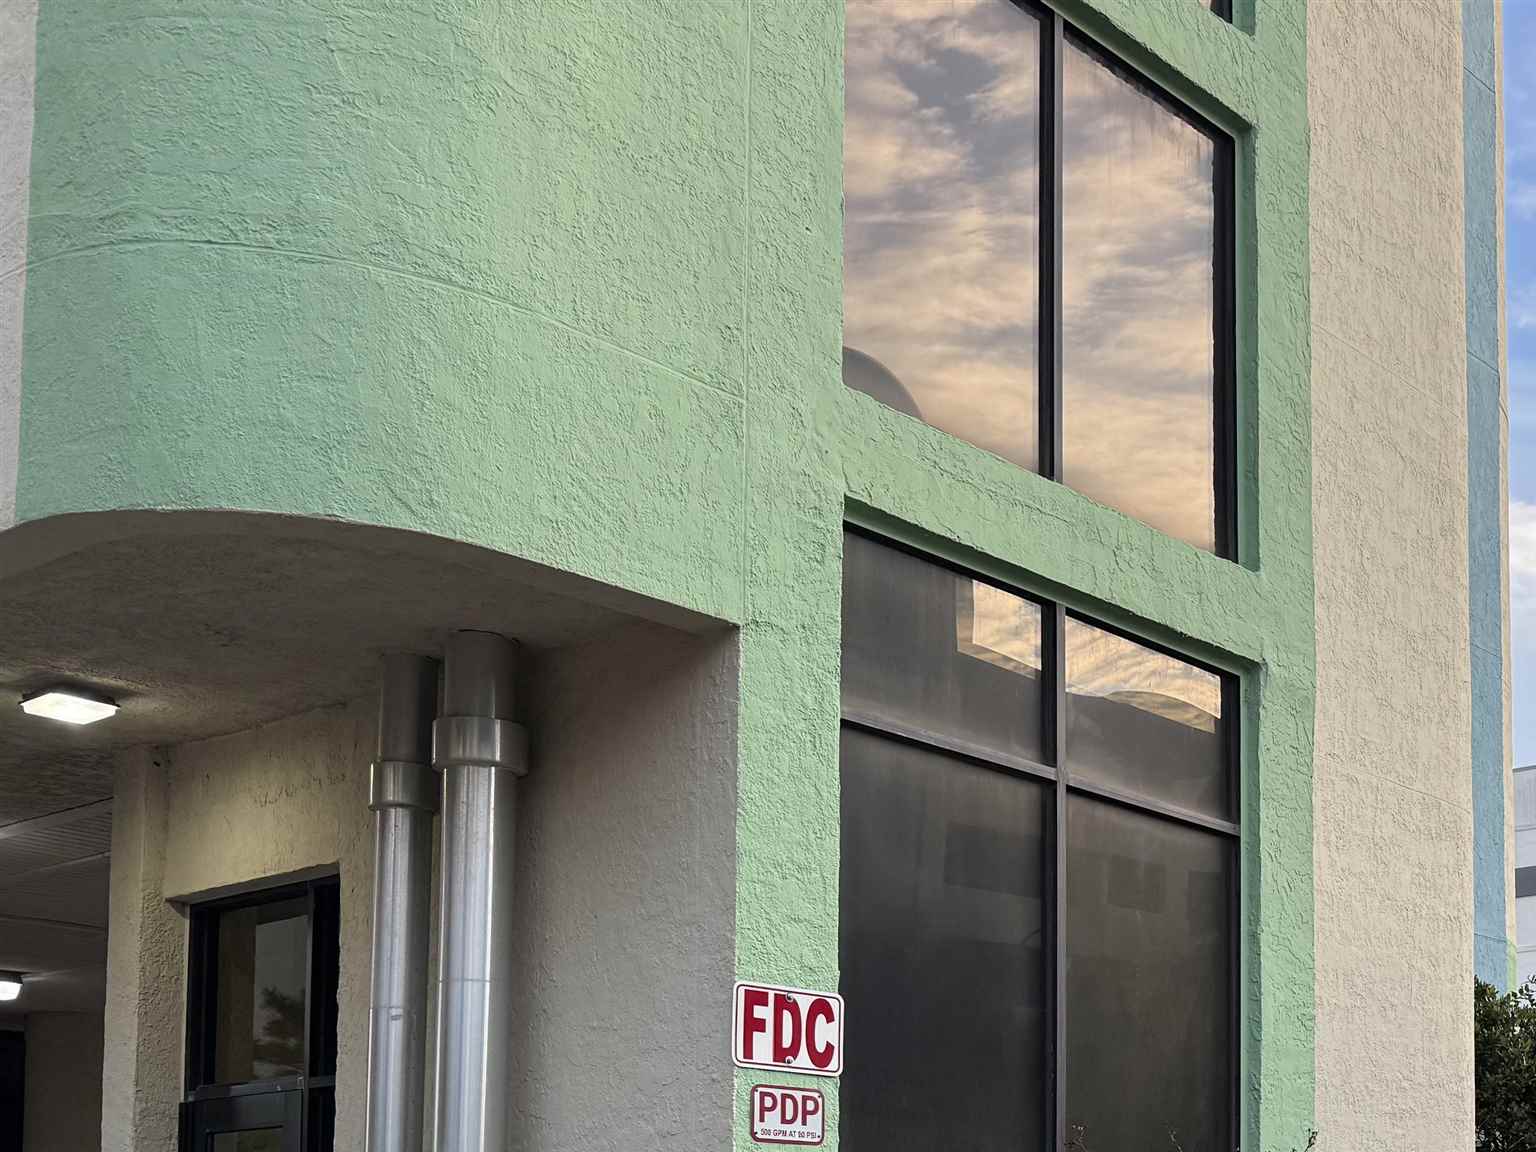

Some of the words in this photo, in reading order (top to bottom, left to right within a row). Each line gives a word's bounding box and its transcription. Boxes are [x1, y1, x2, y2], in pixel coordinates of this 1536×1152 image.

[742, 988, 835, 1069] FDC
[758, 1091, 820, 1126] PDP
[772, 1128, 787, 1137] GPM
[788, 1130, 797, 1138] AT
[806, 1131, 817, 1139] PSI
